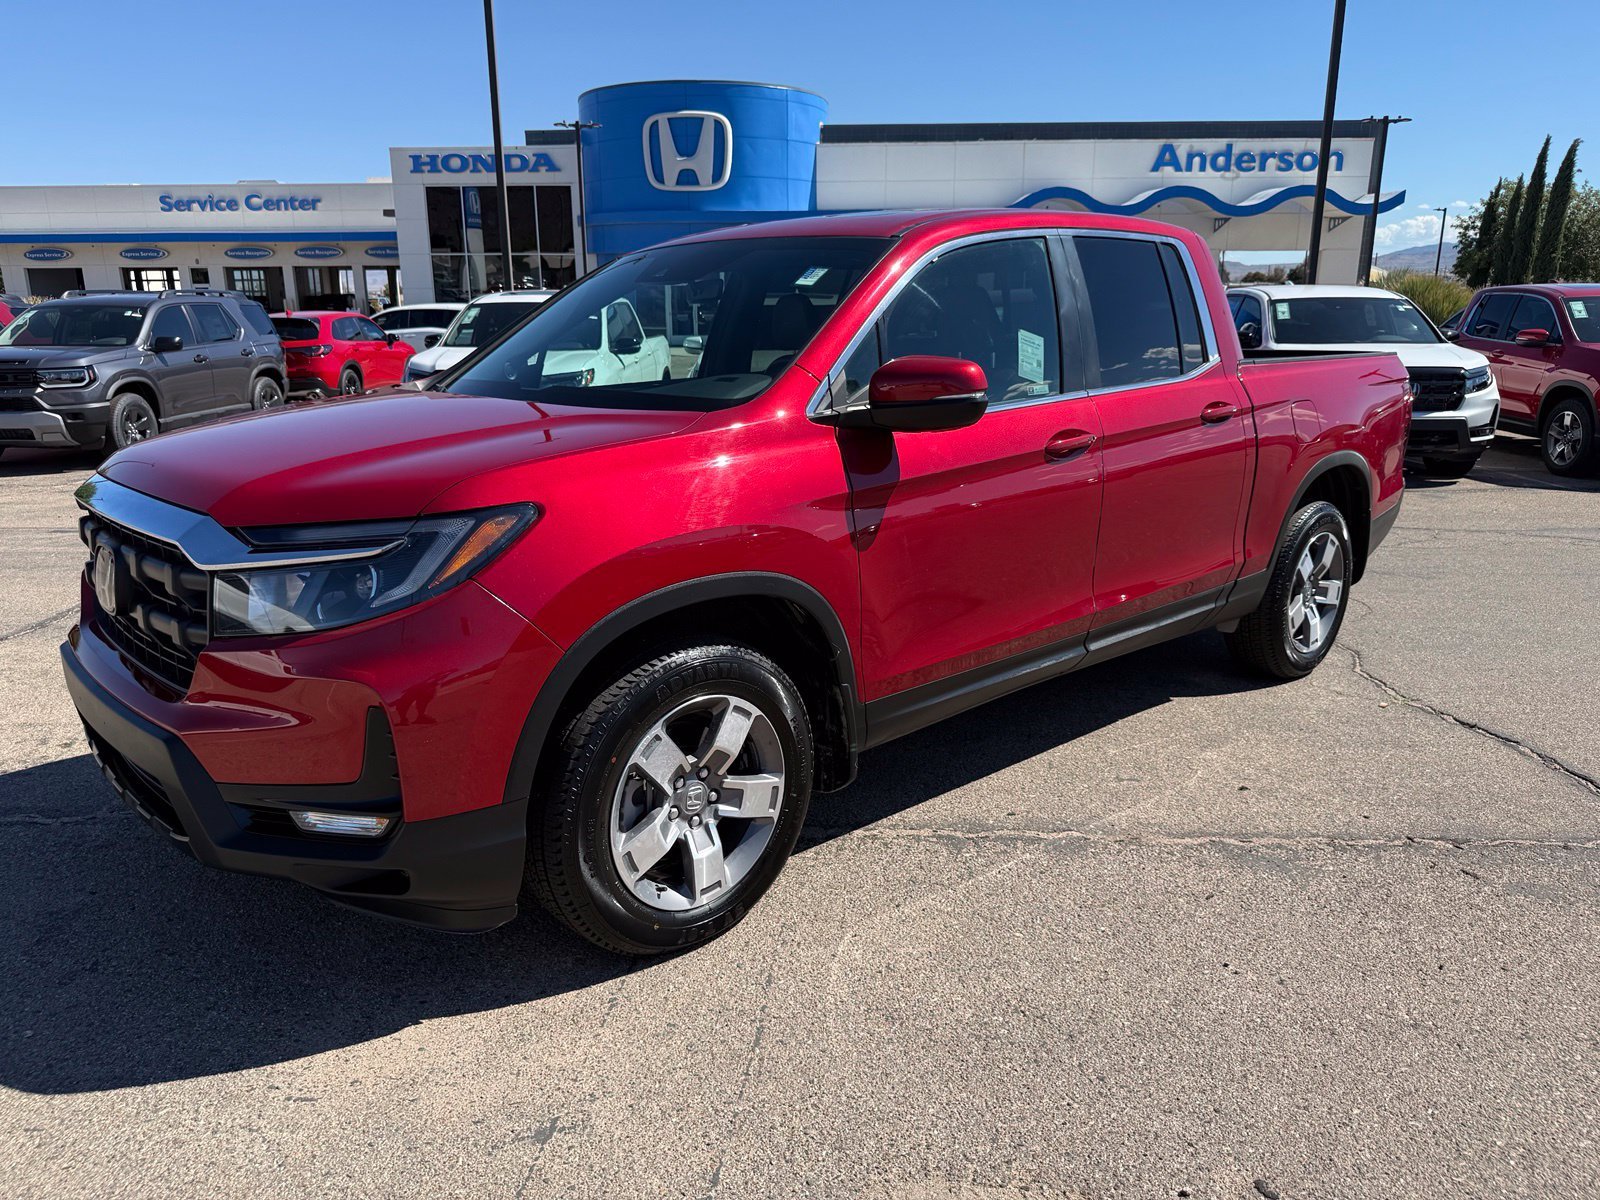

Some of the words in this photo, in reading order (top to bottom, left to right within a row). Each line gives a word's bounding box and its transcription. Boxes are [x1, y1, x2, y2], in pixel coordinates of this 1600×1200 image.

[408, 153, 562, 174] HONDA
[1150, 143, 1345, 173] Anderson
[158, 193, 240, 213] Service
[244, 193, 322, 212] Center
